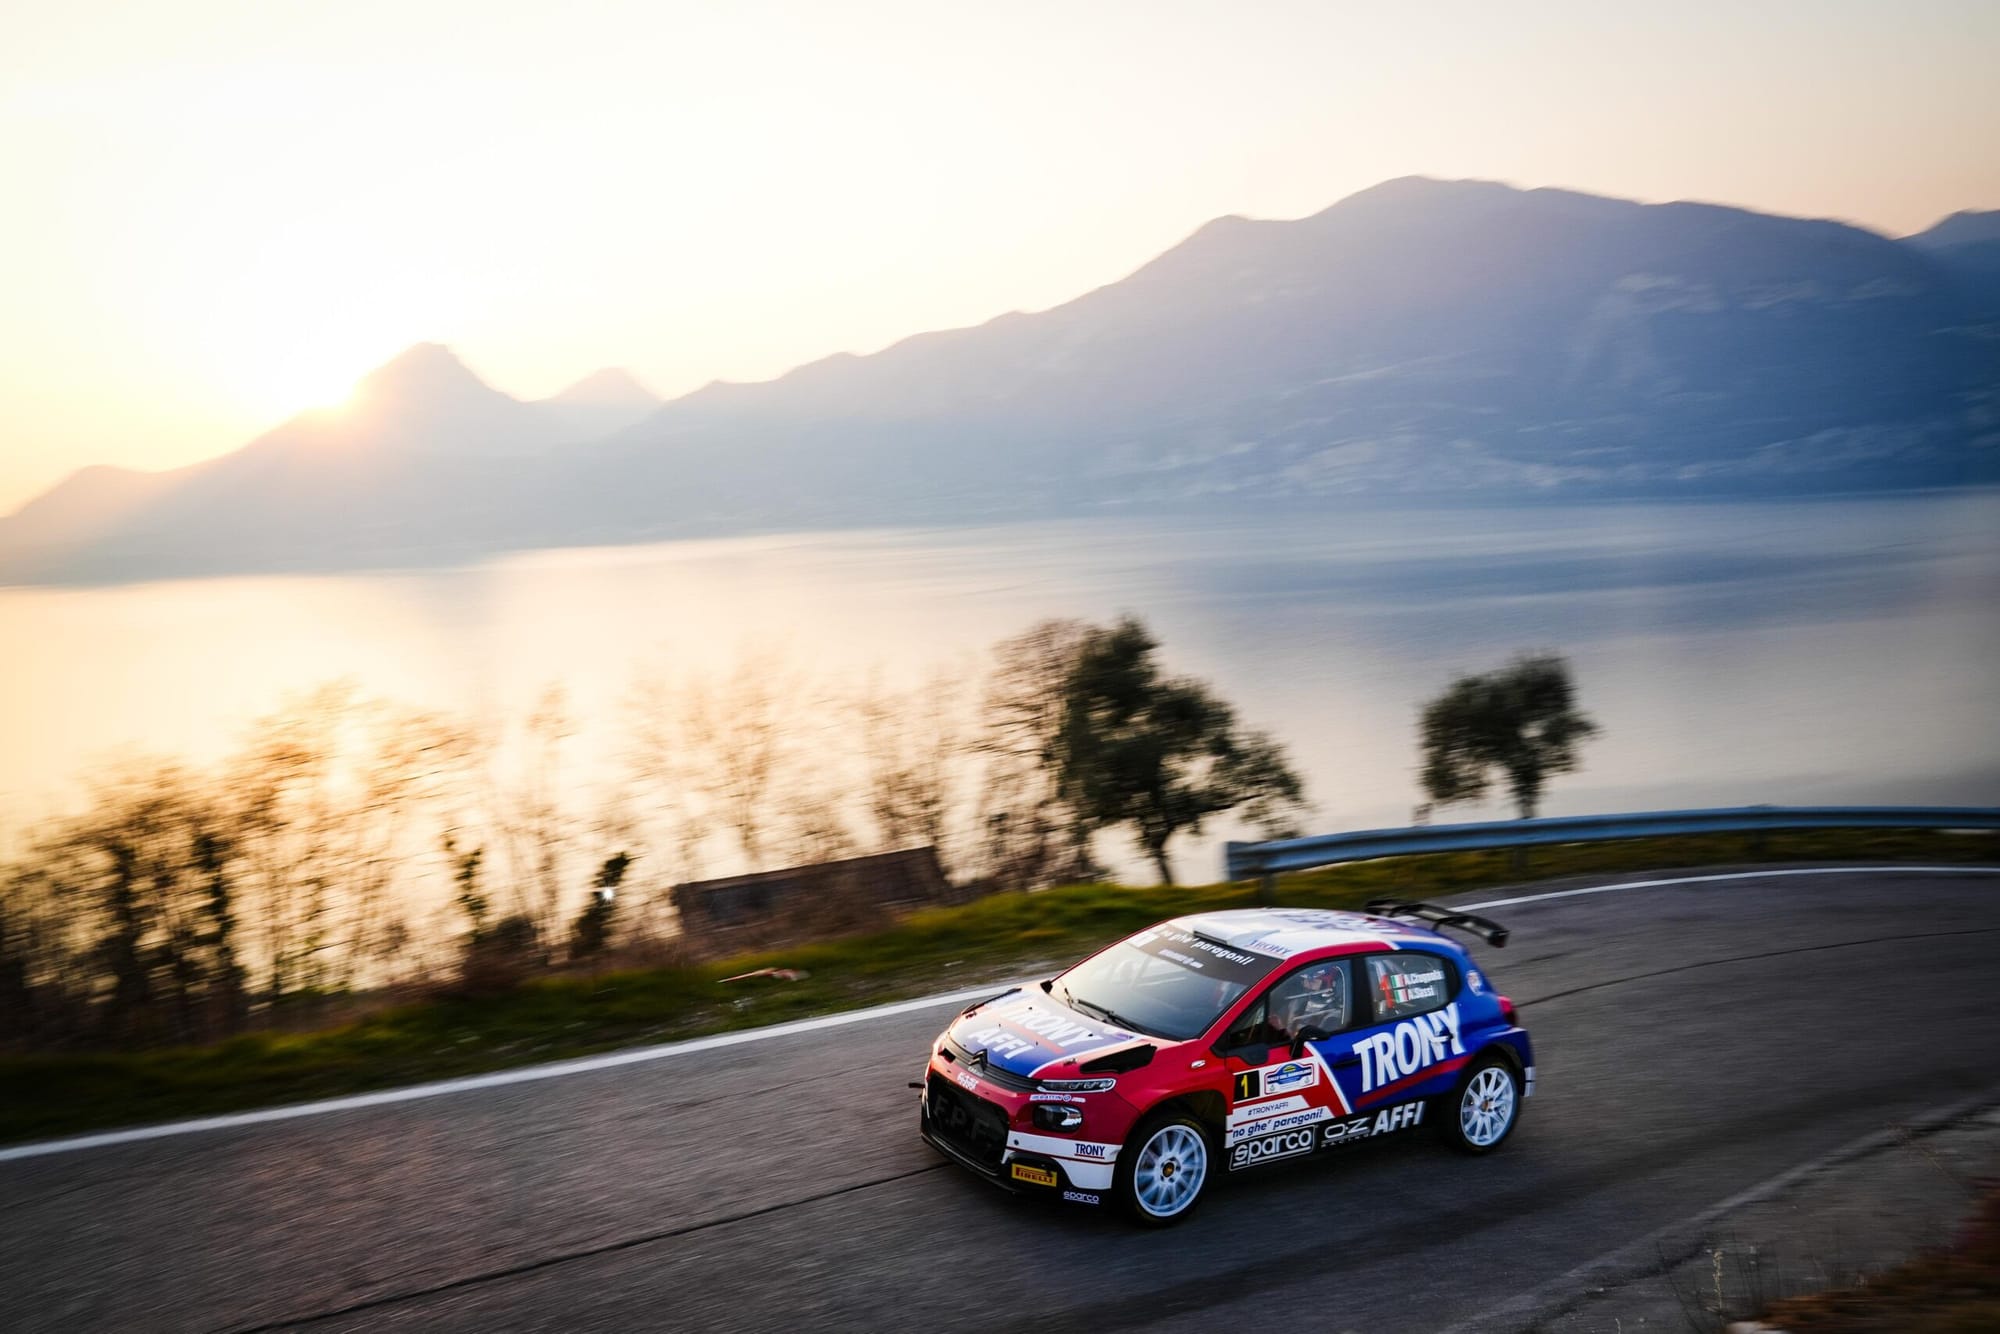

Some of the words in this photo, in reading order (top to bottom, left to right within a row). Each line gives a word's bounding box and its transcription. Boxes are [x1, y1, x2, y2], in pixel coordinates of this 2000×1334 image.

[968, 1027, 1035, 1060] AFFI
[1352, 1002, 1466, 1093] TRONY
[1241, 1074, 1249, 1098] 1
[1248, 1102, 1289, 1116] #TRONYAFFI
[1371, 1101, 1426, 1136] AFFI
[1232, 1128, 1245, 1138] no
[1273, 1108, 1324, 1130] paragoni!
[1075, 1143, 1105, 1156] TRONY
[1234, 1130, 1312, 1164] sparco
[1016, 1167, 1053, 1184] PIRELLI
[1063, 1191, 1099, 1202] sparco
